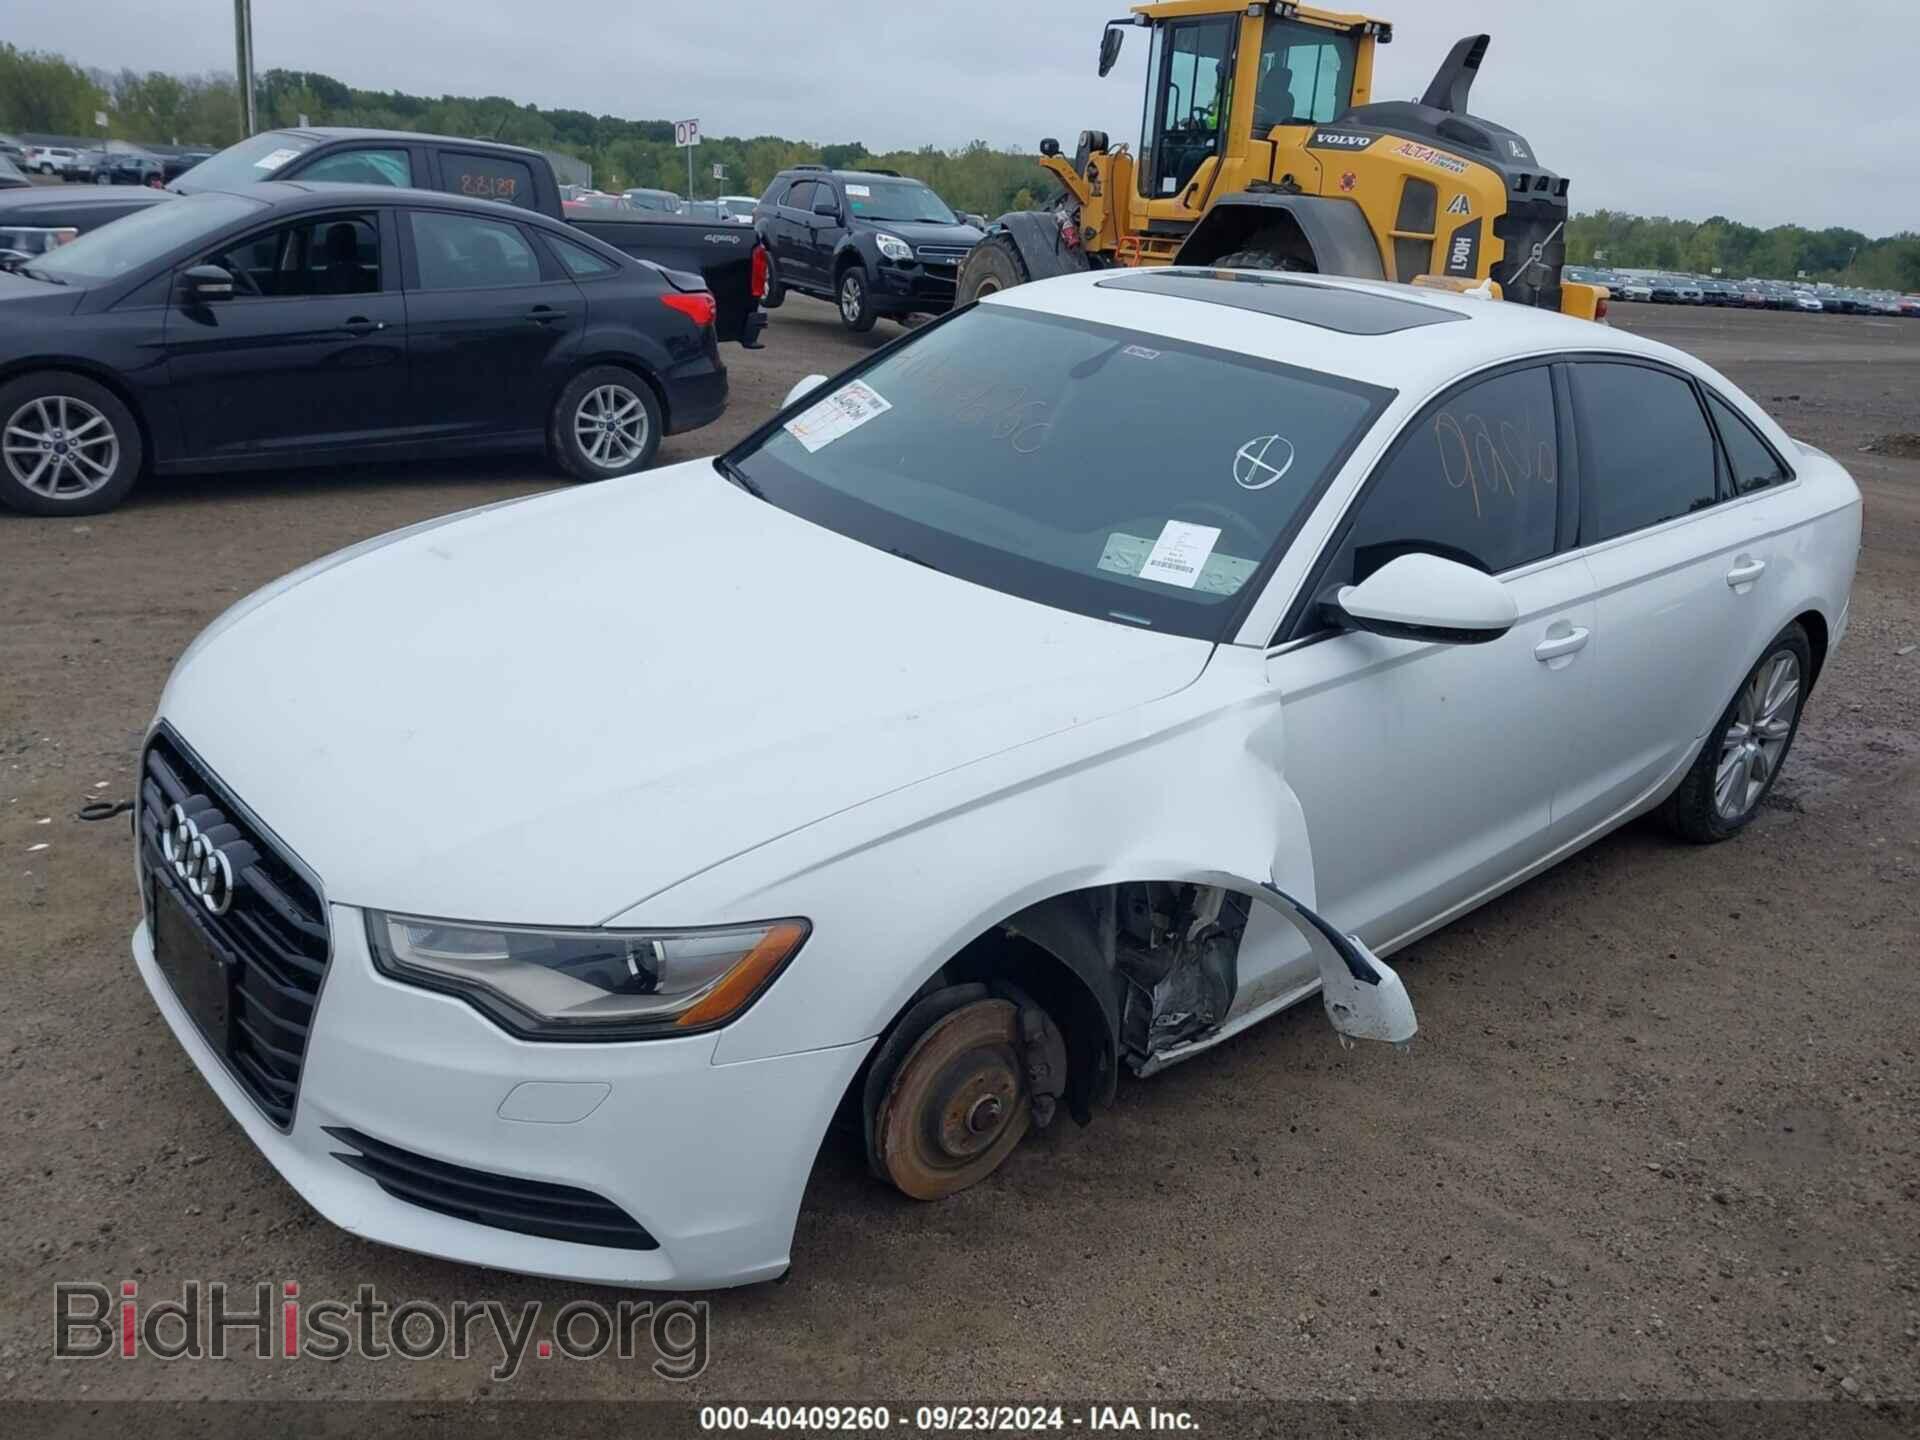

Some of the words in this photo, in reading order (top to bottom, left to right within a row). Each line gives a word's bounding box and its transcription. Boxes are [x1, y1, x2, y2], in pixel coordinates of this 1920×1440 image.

[678, 122, 697, 144] OP
[1317, 133, 1371, 146] VOLVO
[1393, 142, 1435, 161] ALTA
[1450, 237, 1472, 270] L90H
